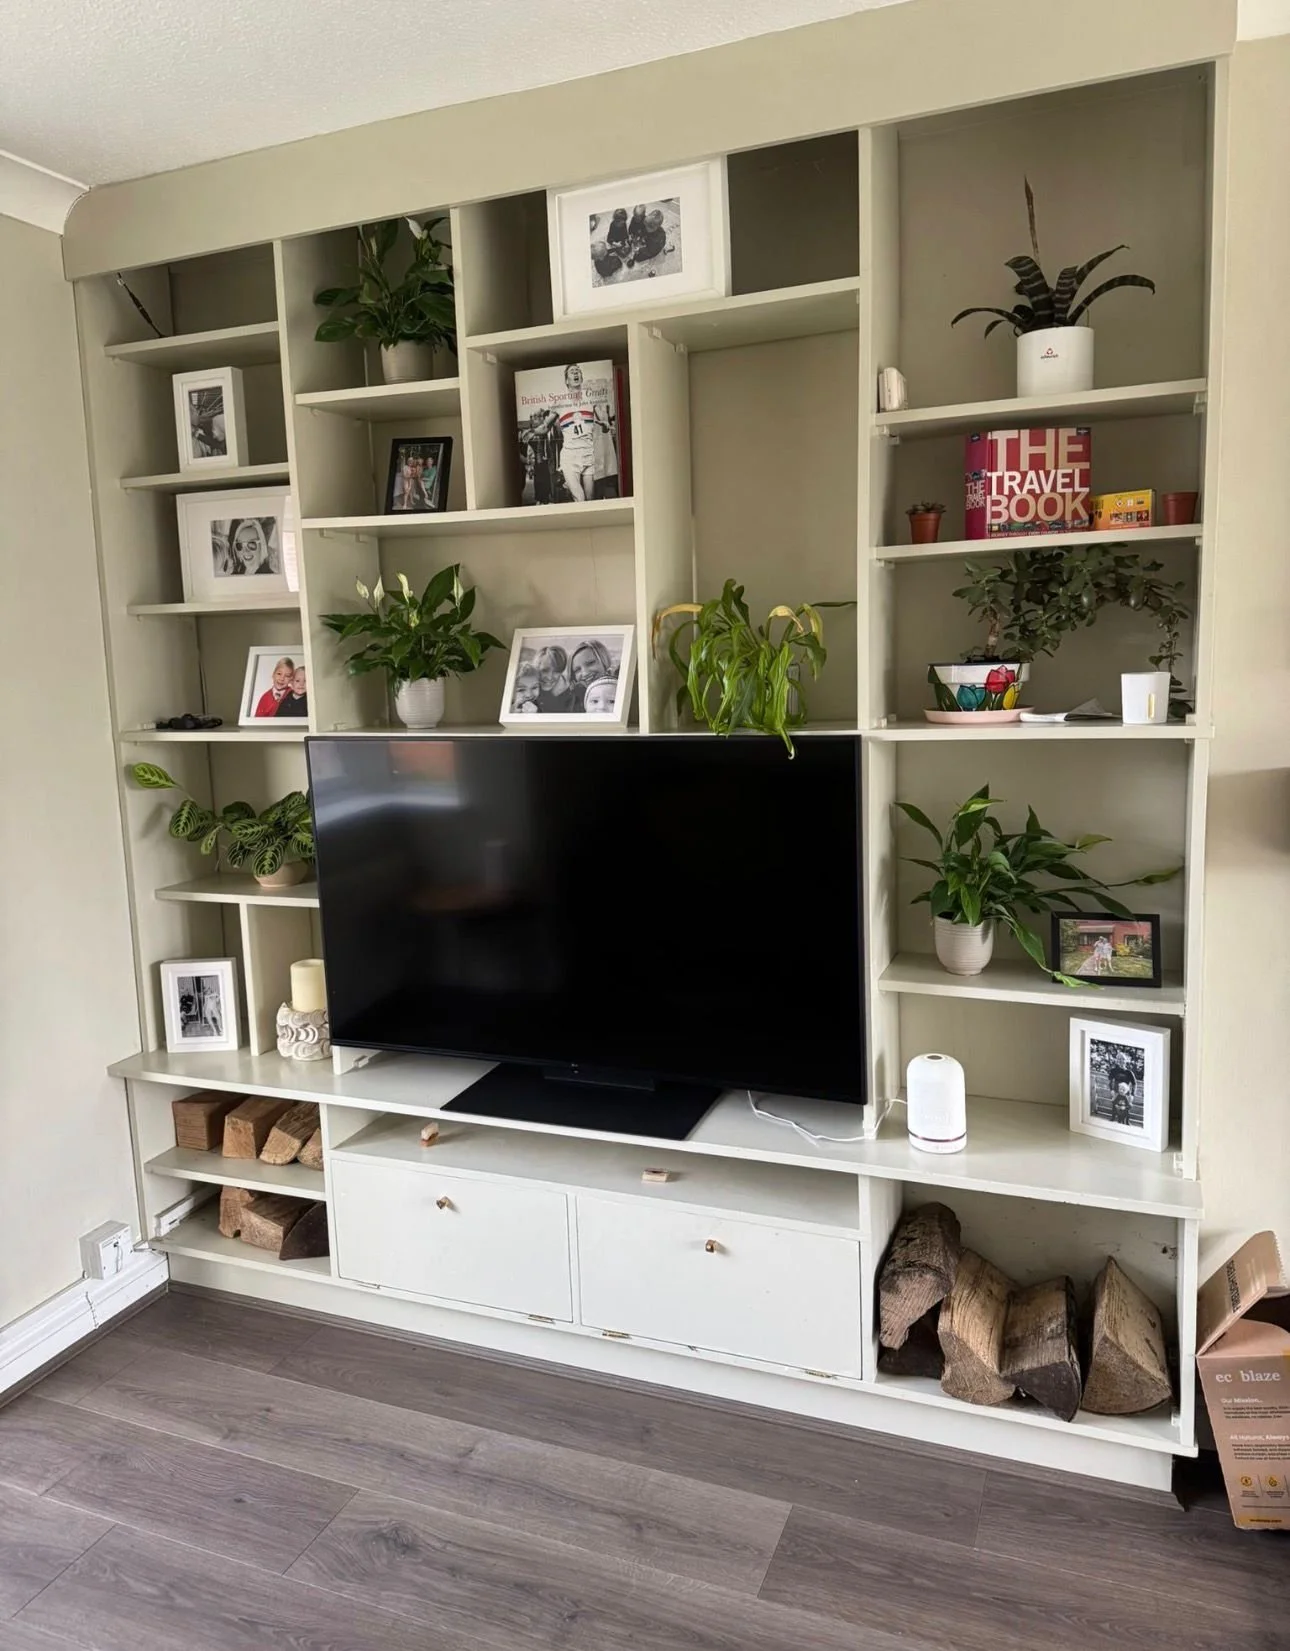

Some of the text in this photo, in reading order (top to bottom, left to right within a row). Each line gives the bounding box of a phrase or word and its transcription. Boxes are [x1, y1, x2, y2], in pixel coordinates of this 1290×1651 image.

[521, 393, 547, 405] British
[548, 391, 583, 404] Sporting
[573, 424, 583, 435] 41
[987, 428, 1090, 472] THE
[966, 480, 985, 494] THE
[987, 468, 1090, 497] TRAVEL
[966, 499, 985, 510] BOOK
[986, 491, 1090, 525] BOOK
[1239, 1369, 1281, 1382] blaze
